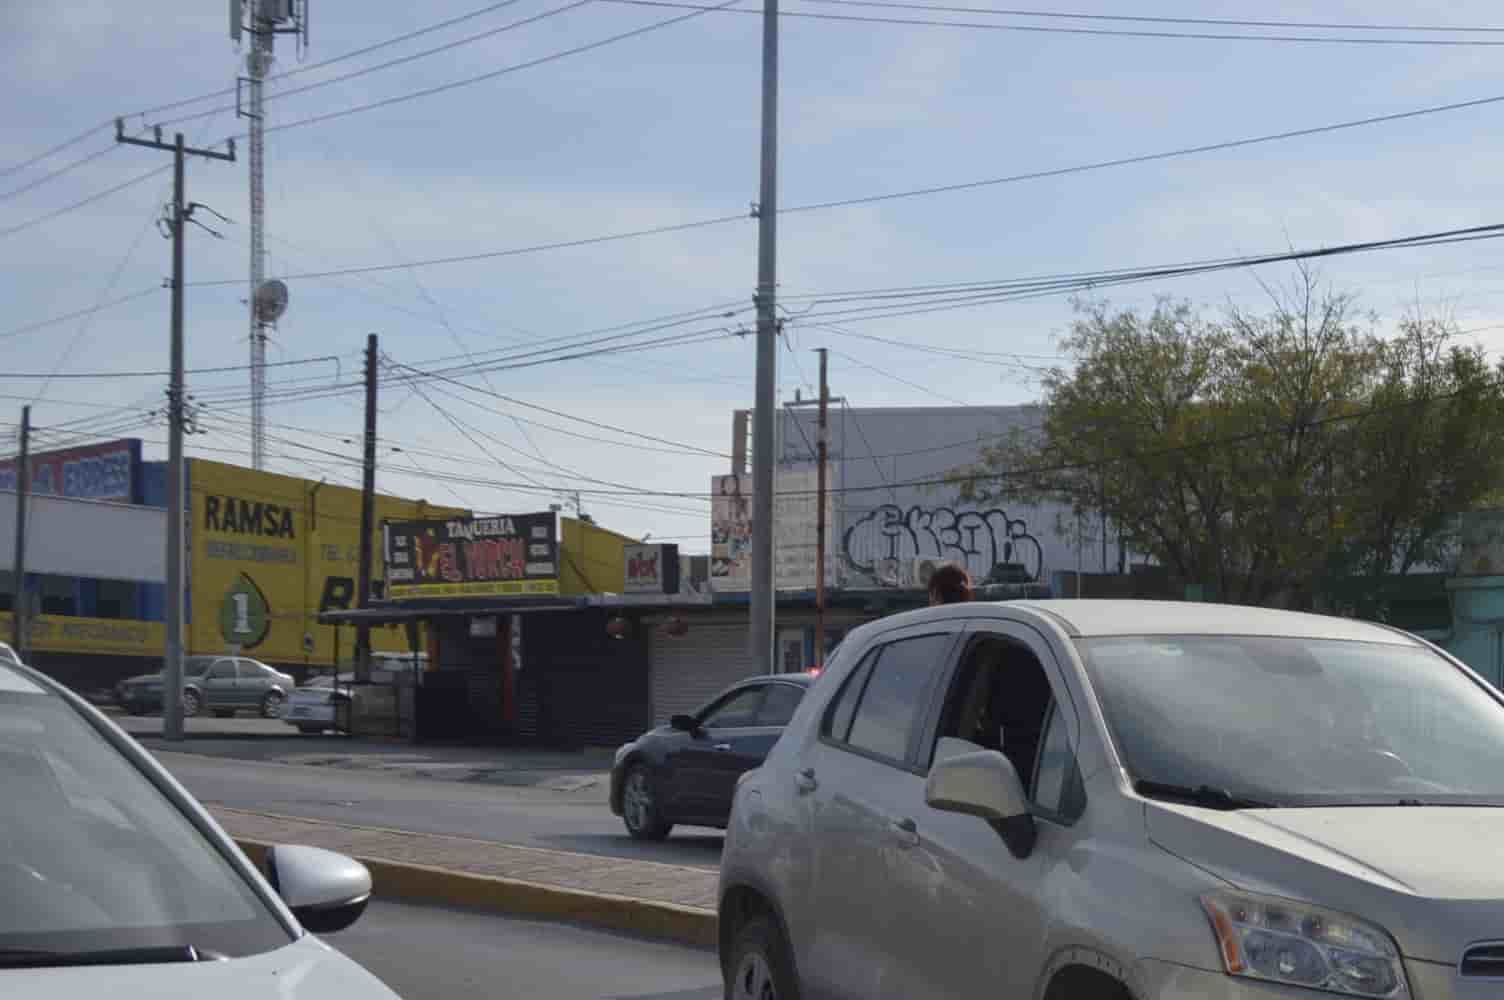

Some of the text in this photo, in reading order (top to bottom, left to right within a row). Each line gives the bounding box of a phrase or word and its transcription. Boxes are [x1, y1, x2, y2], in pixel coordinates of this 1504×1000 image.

[205, 496, 296, 539] RAMSA
[446, 517, 515, 541] TAQUERIA
[231, 593, 252, 633] 1
